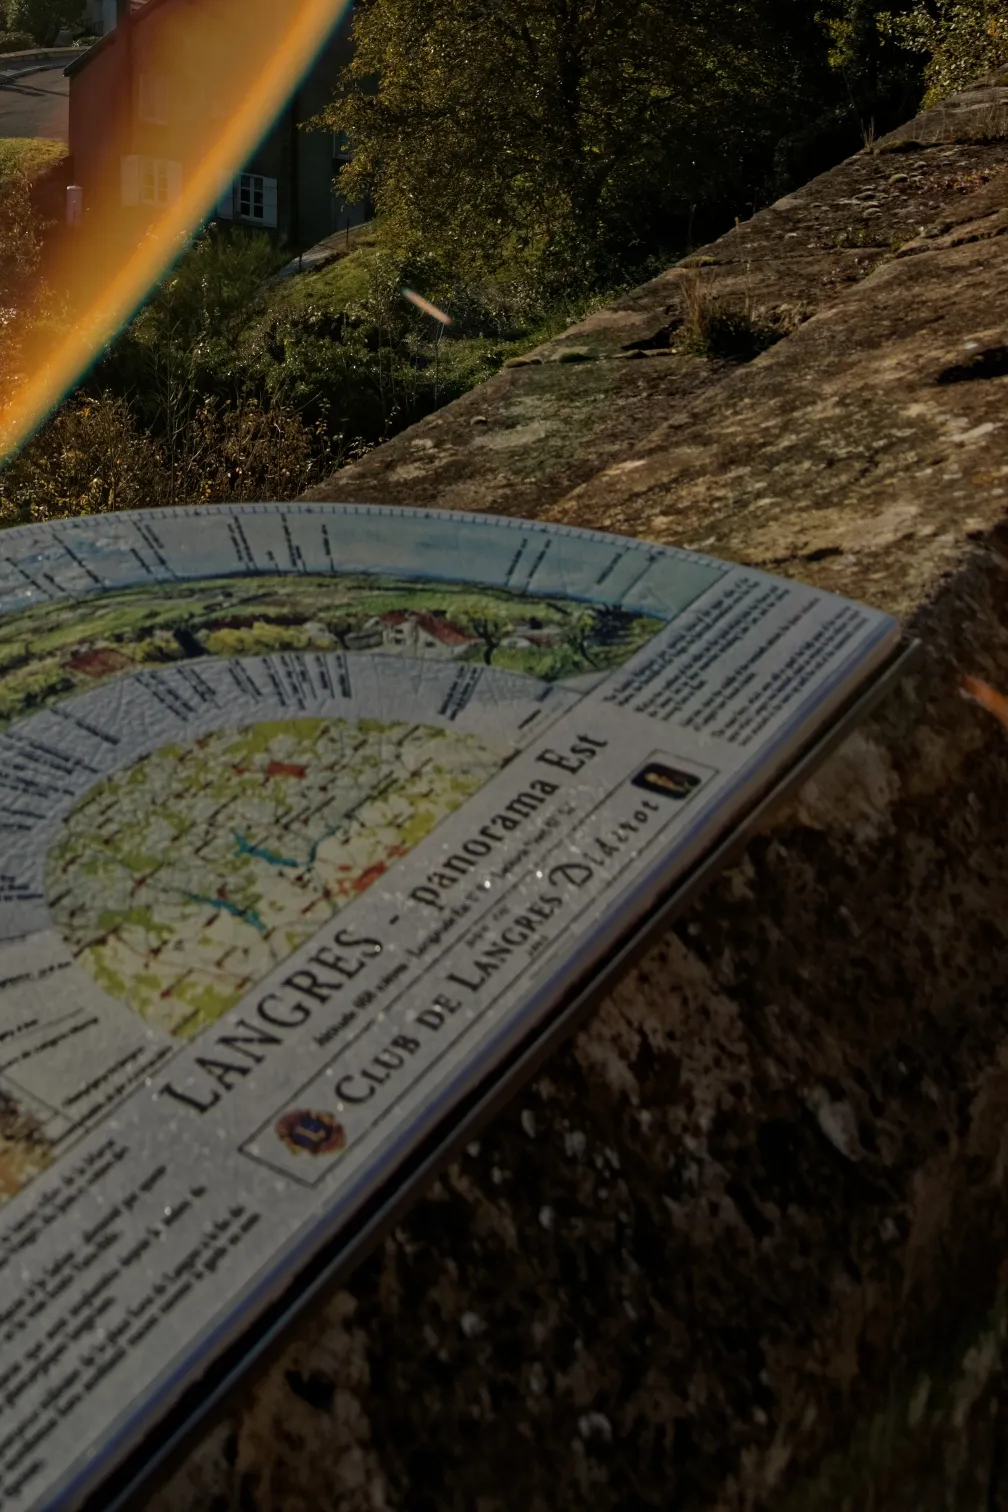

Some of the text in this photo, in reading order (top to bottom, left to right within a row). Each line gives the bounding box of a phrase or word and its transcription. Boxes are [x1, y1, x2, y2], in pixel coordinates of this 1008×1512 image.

[161, 927, 383, 1113] LANGRES
[408, 776, 559, 912] panorama
[535, 731, 610, 781] Est
